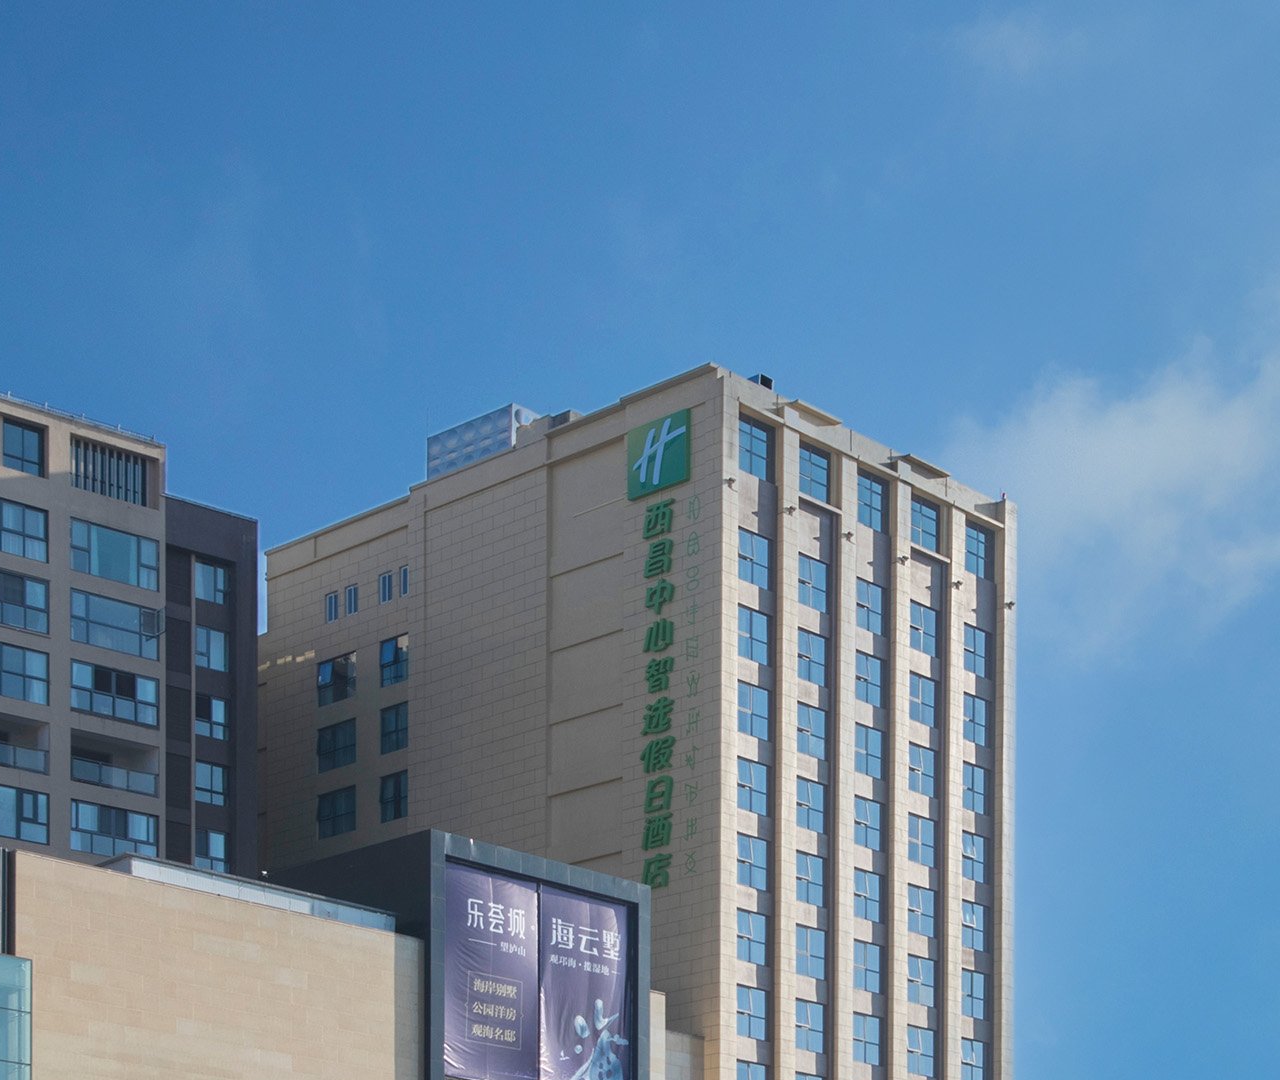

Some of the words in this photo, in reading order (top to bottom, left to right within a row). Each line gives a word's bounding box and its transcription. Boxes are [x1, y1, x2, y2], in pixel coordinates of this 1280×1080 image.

[640, 499, 675, 888] 西昌中心智选假日酒店
[550, 917, 622, 961] 海云墅
[472, 1001, 517, 1021] 公园洋房
